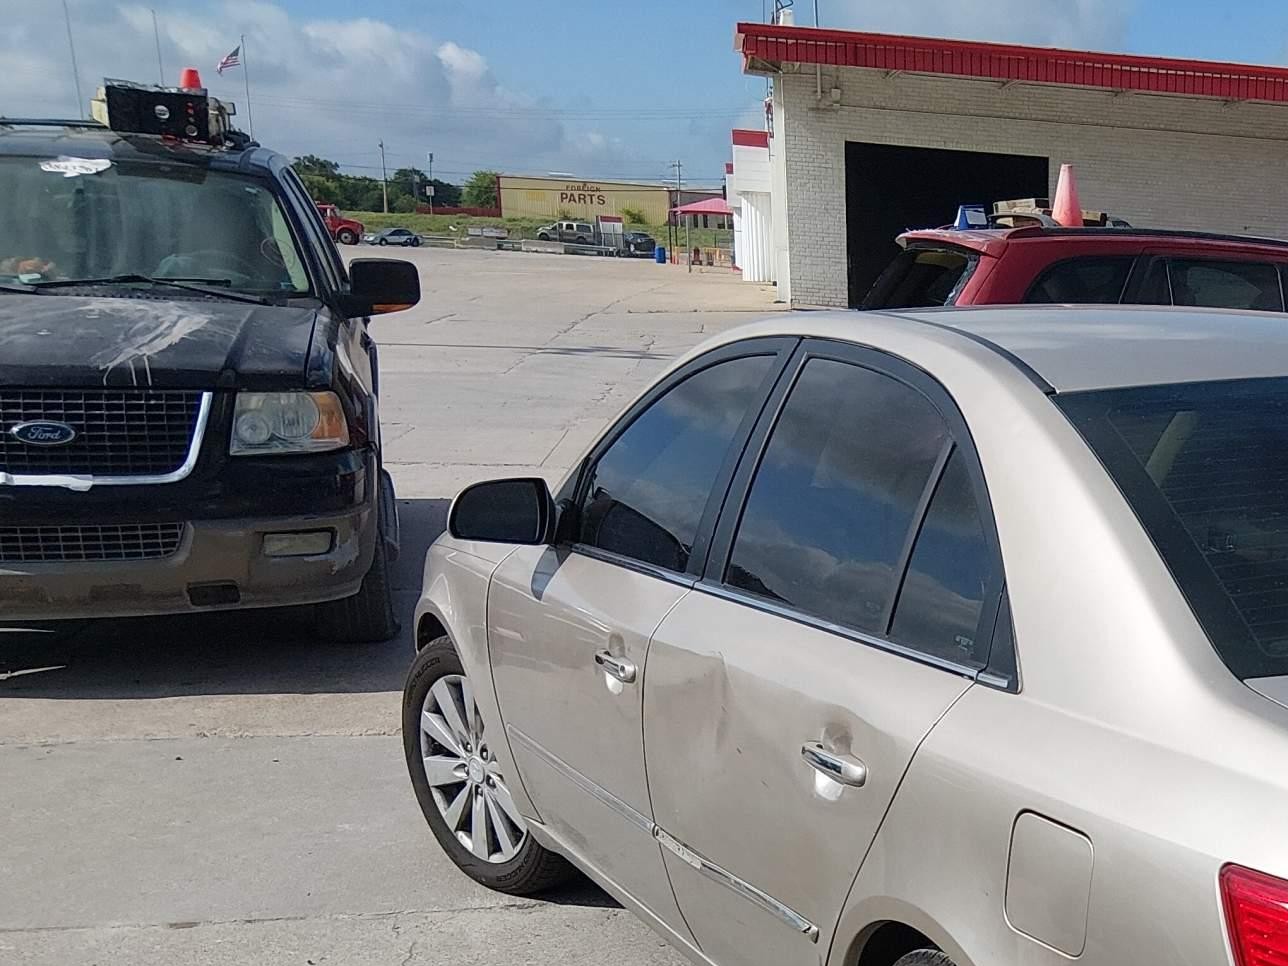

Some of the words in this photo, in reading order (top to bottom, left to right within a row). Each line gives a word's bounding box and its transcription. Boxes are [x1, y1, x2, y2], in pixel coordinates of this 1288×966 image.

[565, 184, 601, 192] FOREIGN
[560, 192, 606, 205] PARTS
[27, 426, 61, 439] Ford
